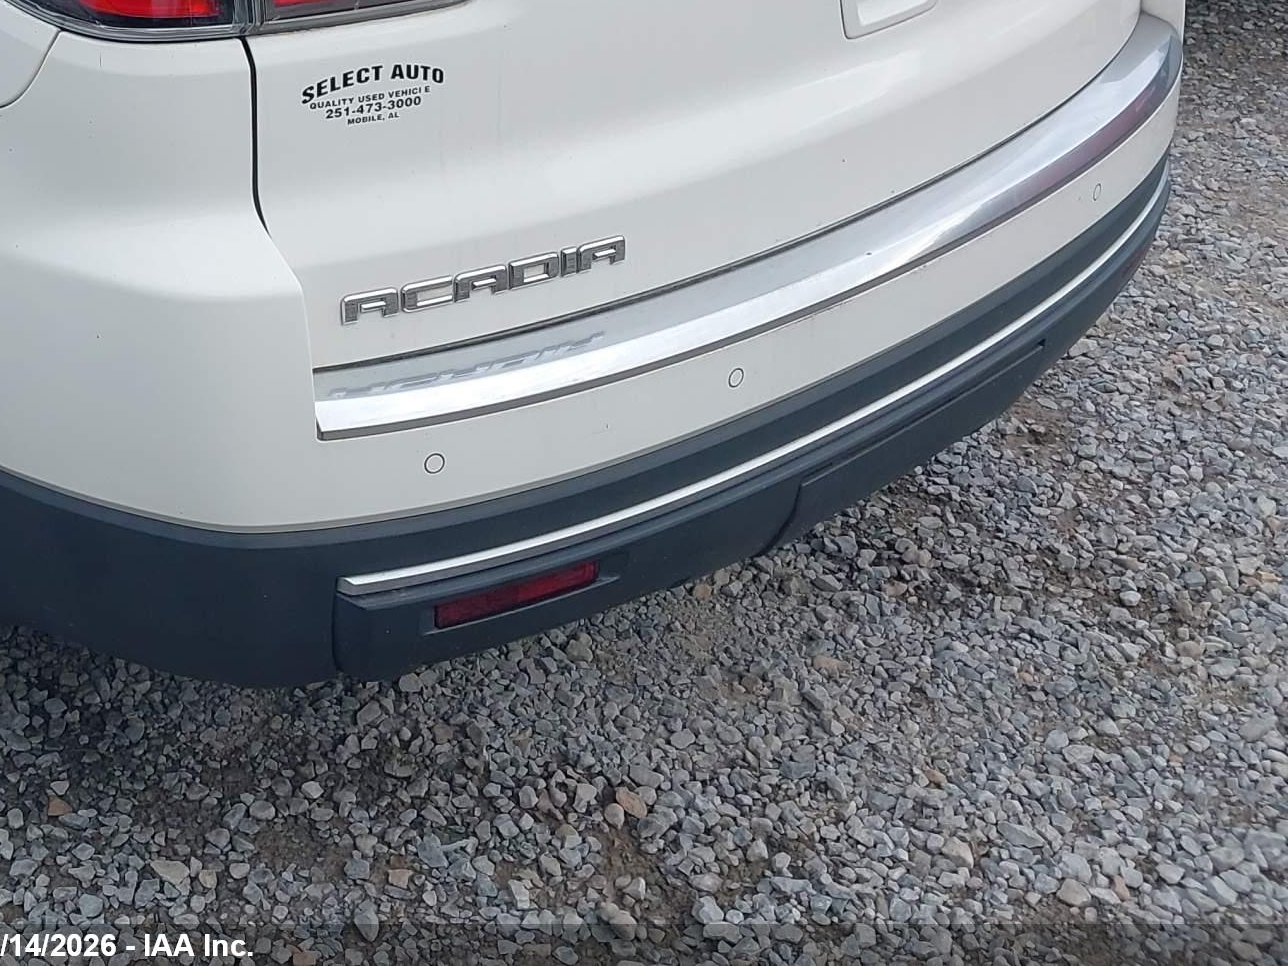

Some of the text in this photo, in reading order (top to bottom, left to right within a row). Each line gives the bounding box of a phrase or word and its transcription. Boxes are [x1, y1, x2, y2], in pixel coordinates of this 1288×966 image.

[301, 64, 444, 105] SELECT AUTO
[309, 97, 354, 110] QUALITY
[358, 93, 385, 103] USED
[325, 95, 422, 120] 251-473-3000
[347, 111, 400, 126] MOBILE, AL
[340, 234, 626, 325] ACADIA
